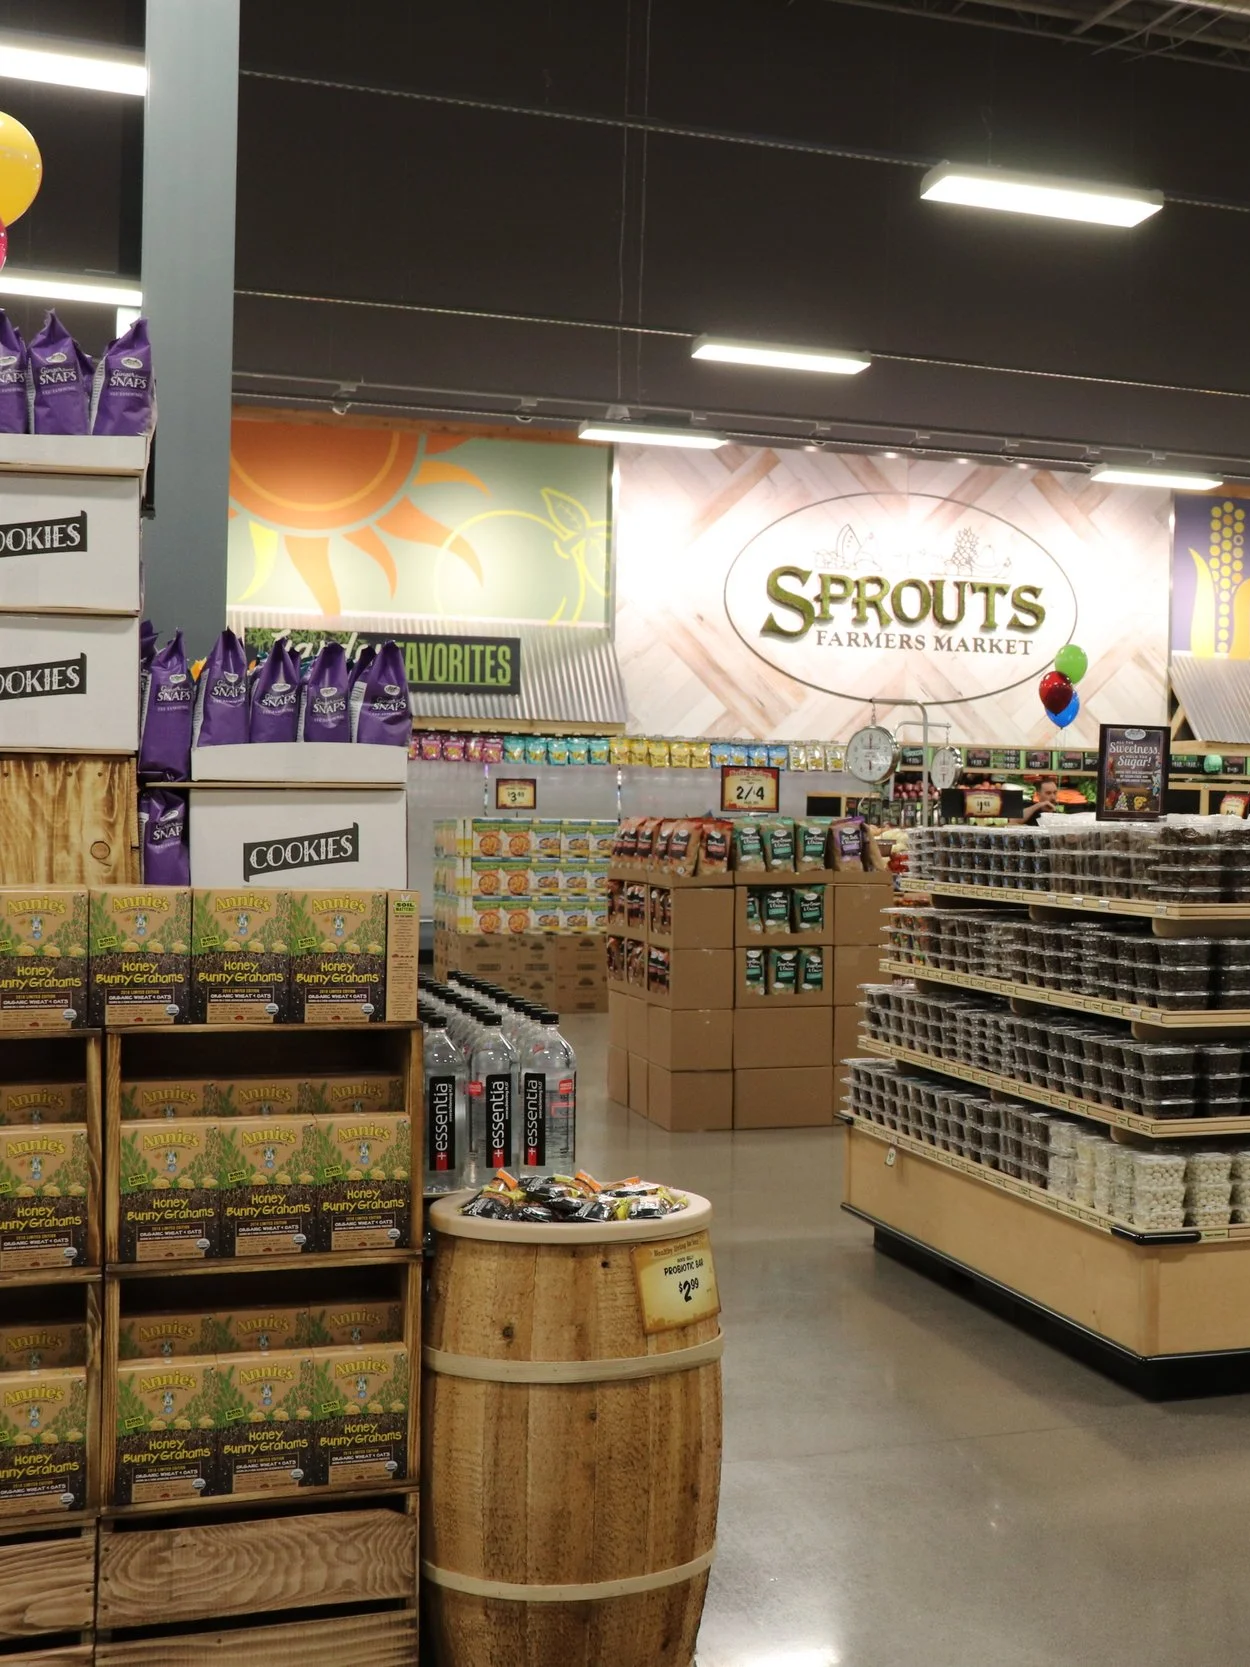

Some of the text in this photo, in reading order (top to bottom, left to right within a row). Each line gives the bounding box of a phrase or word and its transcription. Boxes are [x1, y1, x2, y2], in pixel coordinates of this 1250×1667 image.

[40, 371, 76, 385] SNAPS
[110, 376, 146, 388] SNAPS
[0, 524, 80, 552] OKIES
[760, 566, 1046, 638] SPROUTS
[816, 630, 1034, 656] FARMERS MARKET
[399, 642, 510, 684] FAVORITES
[0, 666, 80, 694] OKIES
[157, 691, 190, 702] SNAPS
[212, 684, 246, 698] SNAPS
[262, 694, 296, 707] SNAPS
[313, 701, 346, 714] SNAPS
[372, 698, 406, 711] SNAPS
[1118, 756, 1152, 770] Sugar!
[154, 826, 182, 840] SNAP
[250, 834, 352, 869] COOKIES
[7, 896, 66, 915] Annie's
[112, 893, 169, 913] Annie's
[216, 892, 271, 912] Annie's
[312, 896, 366, 914] Annie's
[18, 966, 54, 977] Honey
[122, 962, 158, 974] Honey
[224, 961, 259, 973] Honey
[320, 962, 354, 973] Honey
[0, 978, 82, 990] unny Grahams
[96, 973, 184, 986] Bunny Grahams
[198, 972, 284, 985] Bunny Grahams
[296, 972, 379, 984] Bunny Grahams
[434, 1083, 448, 1151] essentia
[490, 1081, 504, 1148] essentia
[526, 1080, 538, 1146] essentia
[143, 1129, 200, 1150] Annie's
[242, 1126, 297, 1147] Annie's
[338, 1123, 391, 1142] Annie's
[6, 1136, 66, 1158] Annie's
[252, 1194, 286, 1206] Honey
[347, 1189, 380, 1200] Honey
[153, 1198, 188, 1210] Honey
[227, 1203, 311, 1217] Bunny Grahams
[323, 1198, 405, 1212] Bunny Grahams
[18, 1206, 56, 1218] Honey
[127, 1207, 214, 1222] Bunny Grahams
[0, 1216, 82, 1231] unny Grahams
[664, 1261, 695, 1276] PROBIOTIC
[695, 1258, 704, 1269] BAR
[239, 1363, 295, 1383] Annie's
[335, 1357, 390, 1377] Annie's
[140, 1371, 196, 1392] Annie's
[2, 1384, 64, 1407] Annie's
[249, 1430, 284, 1441] Honey
[344, 1423, 378, 1434] Honey
[150, 1439, 185, 1450] Honey
[224, 1438, 308, 1454] Bunny Grahams
[320, 1432, 402, 1447] Bunny Grahams
[15, 1454, 53, 1466] Honey
[123, 1448, 210, 1464] Bunny Grahams
[0, 1462, 79, 1479] nny Grahams
